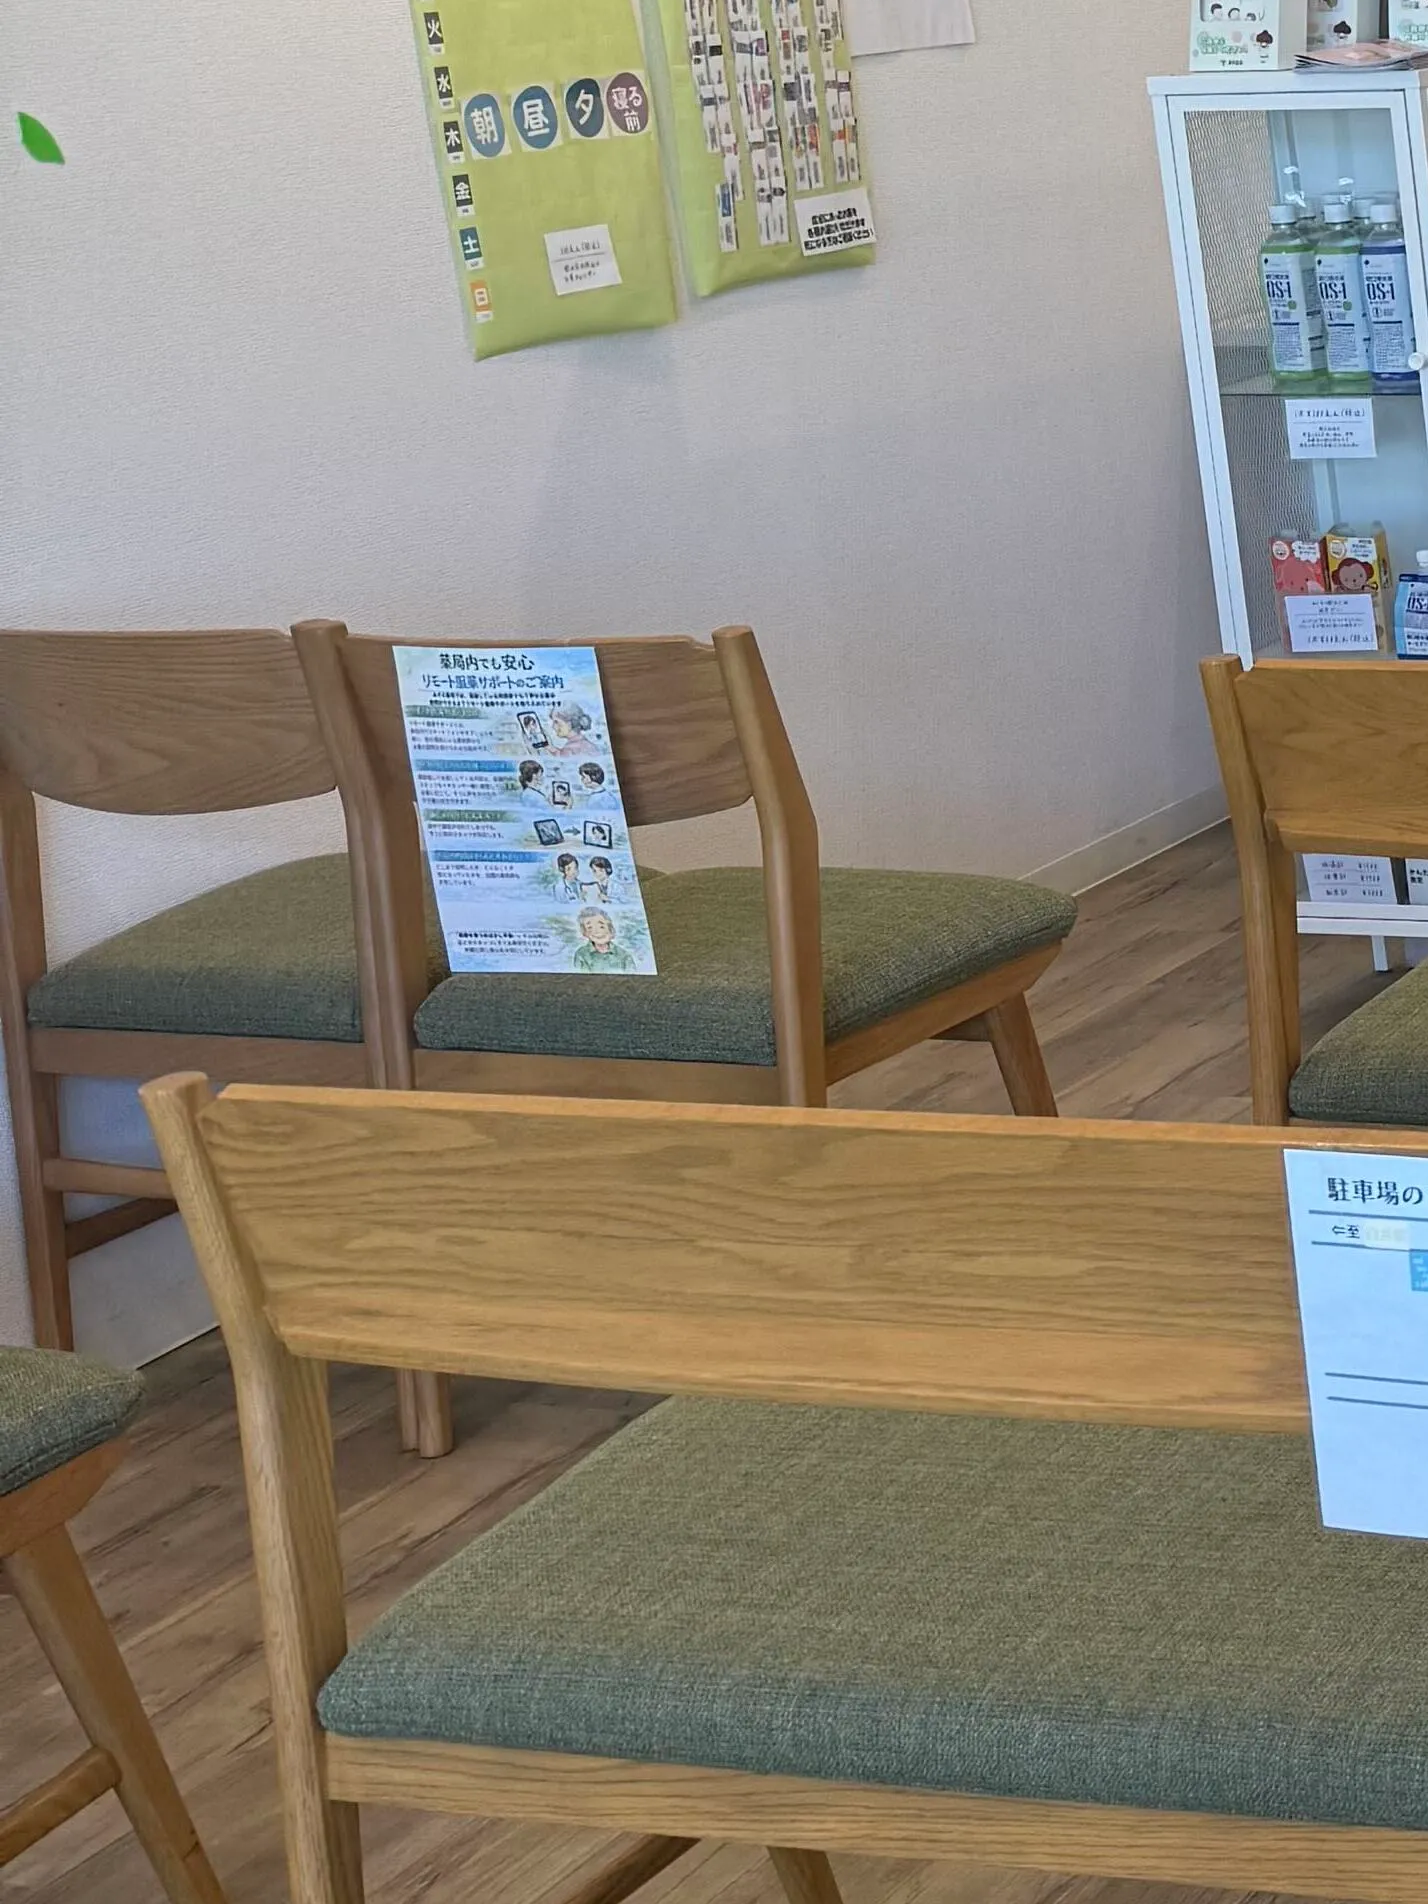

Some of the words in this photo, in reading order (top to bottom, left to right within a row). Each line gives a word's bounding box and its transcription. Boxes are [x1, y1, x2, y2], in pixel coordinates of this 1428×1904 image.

[427, 19, 442, 39] 火
[436, 73, 450, 93] 水
[574, 87, 595, 125] 夕
[611, 86, 643, 110] 寝る
[470, 105, 499, 145] 朝
[522, 98, 550, 137] 昼
[624, 111, 642, 131] 前
[445, 128, 461, 146] 木
[455, 182, 471, 201] 金
[463, 235, 479, 254] 土
[439, 653, 536, 671] 薬局内でも安心
[422, 673, 565, 690] リモート服薬サポートのご案内
[1346, 1224, 1360, 1240] 至
